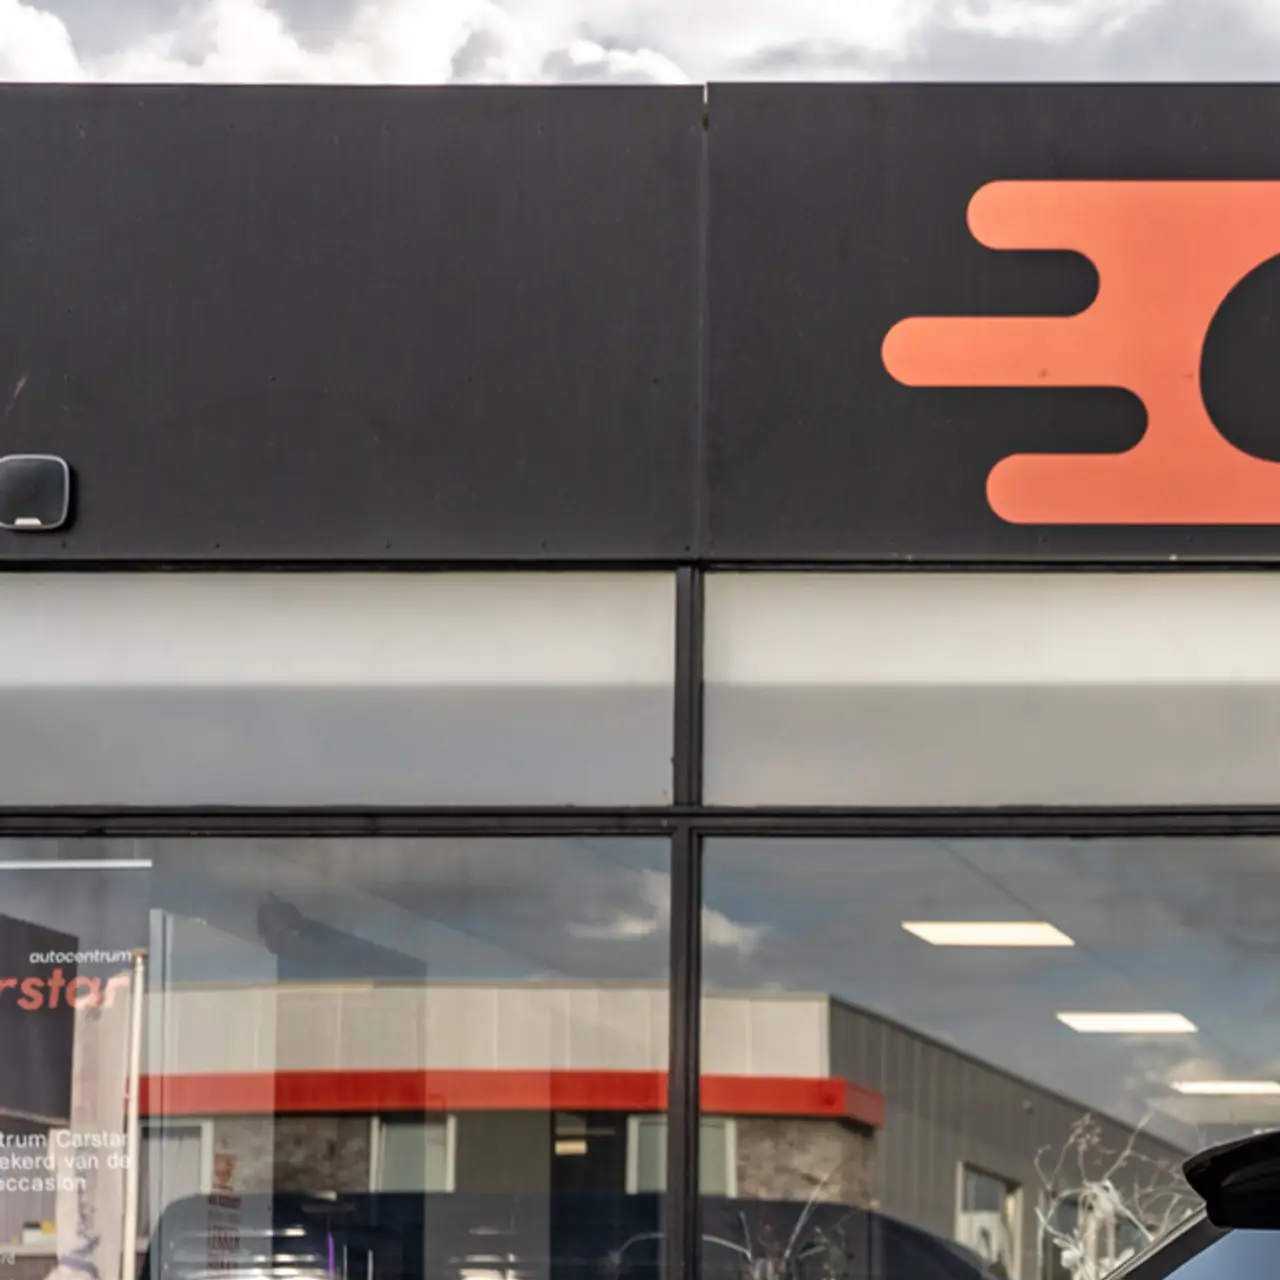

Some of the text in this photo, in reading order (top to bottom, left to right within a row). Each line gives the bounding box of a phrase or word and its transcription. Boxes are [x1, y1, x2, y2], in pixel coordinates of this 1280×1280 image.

[29, 948, 132, 964] autocentrum
[56, 1130, 128, 1148] Carstar
[64, 1157, 99, 1170] van
